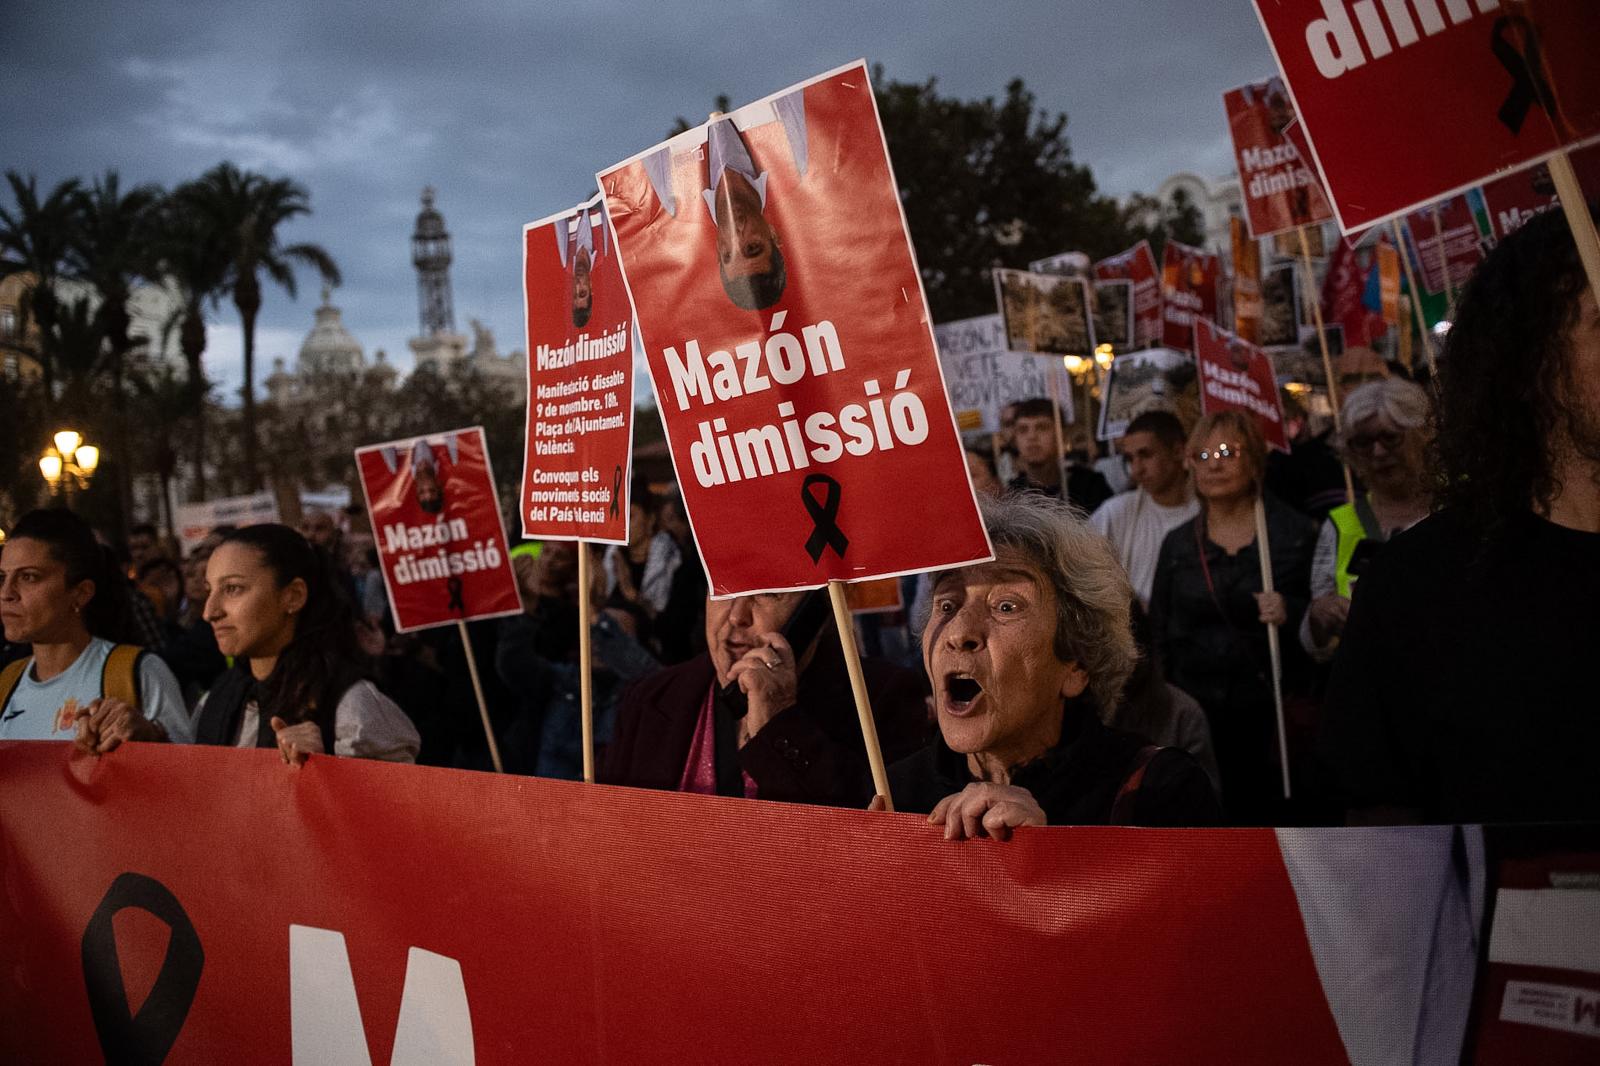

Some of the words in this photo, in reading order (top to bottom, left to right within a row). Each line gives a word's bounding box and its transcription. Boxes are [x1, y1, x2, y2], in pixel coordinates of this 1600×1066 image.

[575, 321, 627, 362] dimissió
[663, 310, 846, 412] Mazón
[592, 370, 625, 391] dissabte
[536, 403, 543, 418] 9
[545, 402, 558, 417] de
[535, 421, 563, 438] Plaça
[690, 368, 929, 488] dimissió
[581, 466, 600, 482] els
[581, 486, 611, 503] socials
[530, 506, 547, 521] del
[549, 506, 573, 522] País
[383, 513, 469, 554] Mazón
[393, 538, 502, 585] dimissió
